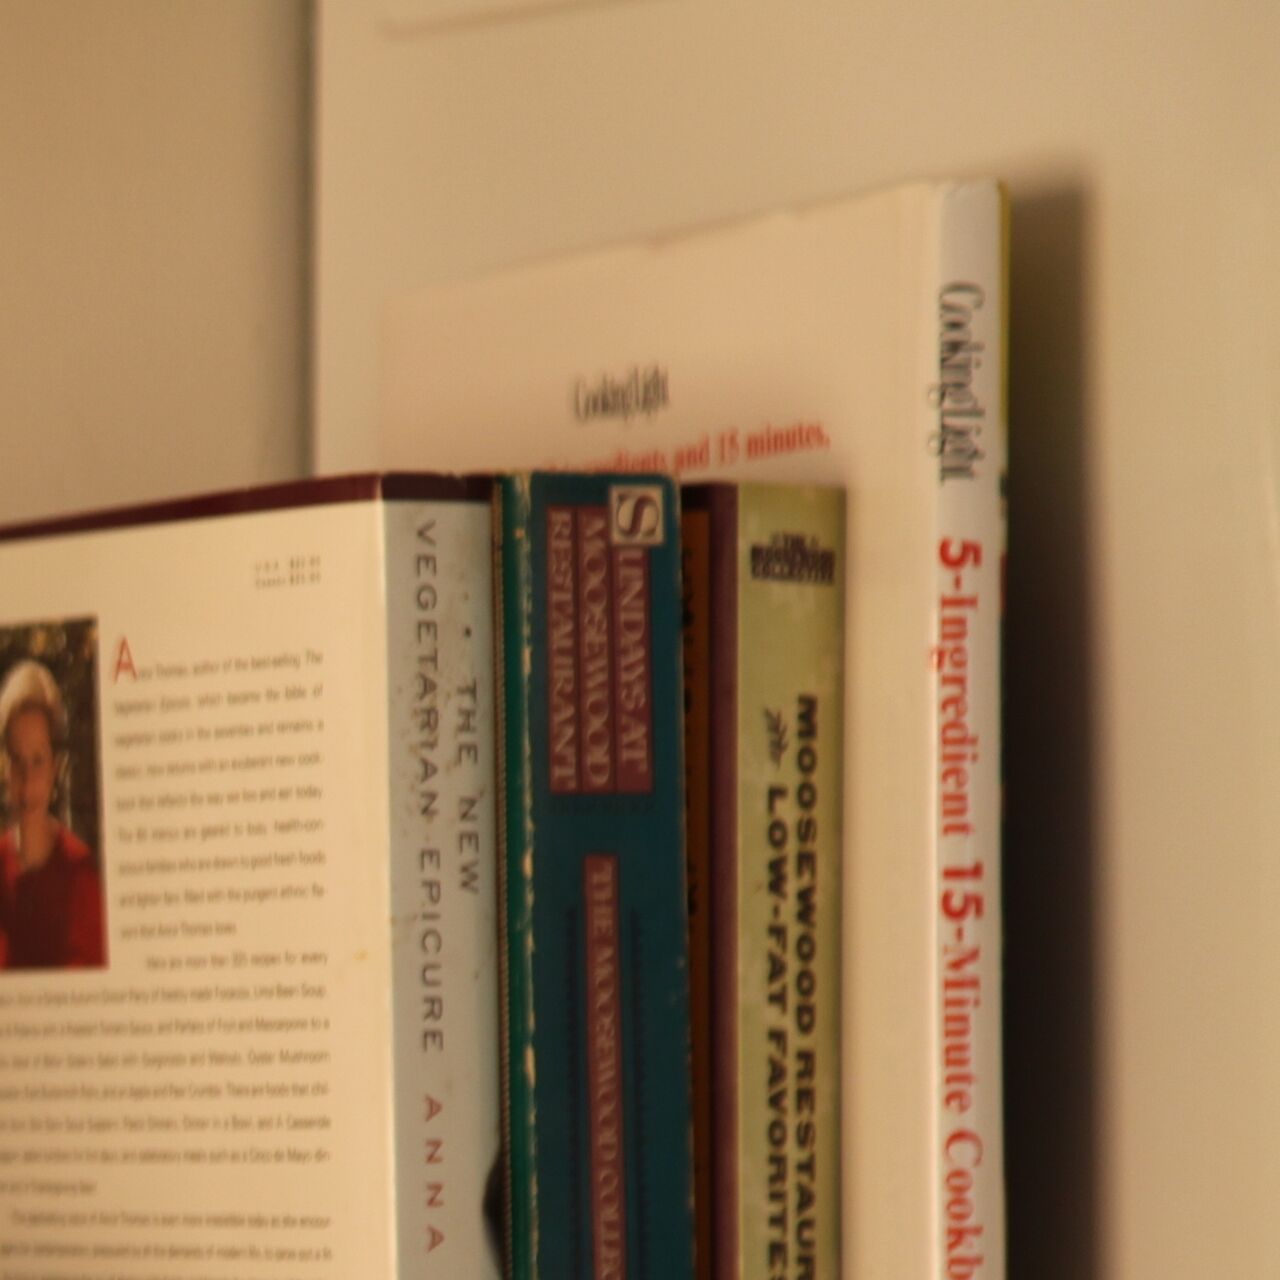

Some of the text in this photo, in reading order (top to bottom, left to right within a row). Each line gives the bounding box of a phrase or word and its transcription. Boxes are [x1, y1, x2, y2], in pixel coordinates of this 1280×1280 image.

[675, 434, 710, 472] and
[718, 427, 739, 466] 15
[551, 511, 576, 790] RESTAURANT
[581, 514, 610, 787] MOOSEWOOD
[616, 495, 659, 772] SUNDAYS AT
[929, 537, 982, 837] 5-Ingredient
[415, 518, 444, 1053] VEGETARIAN EPICURE
[456, 680, 480, 894] THE NEW
[592, 862, 615, 937] THE
[767, 785, 789, 1004] LOW-FAT
[795, 695, 818, 1038] MOOSEWOOD
[593, 945, 618, 1161] MOOSEWOOD
[941, 861, 984, 1113] 15-Minute
[423, 1096, 445, 1253] ANNA
